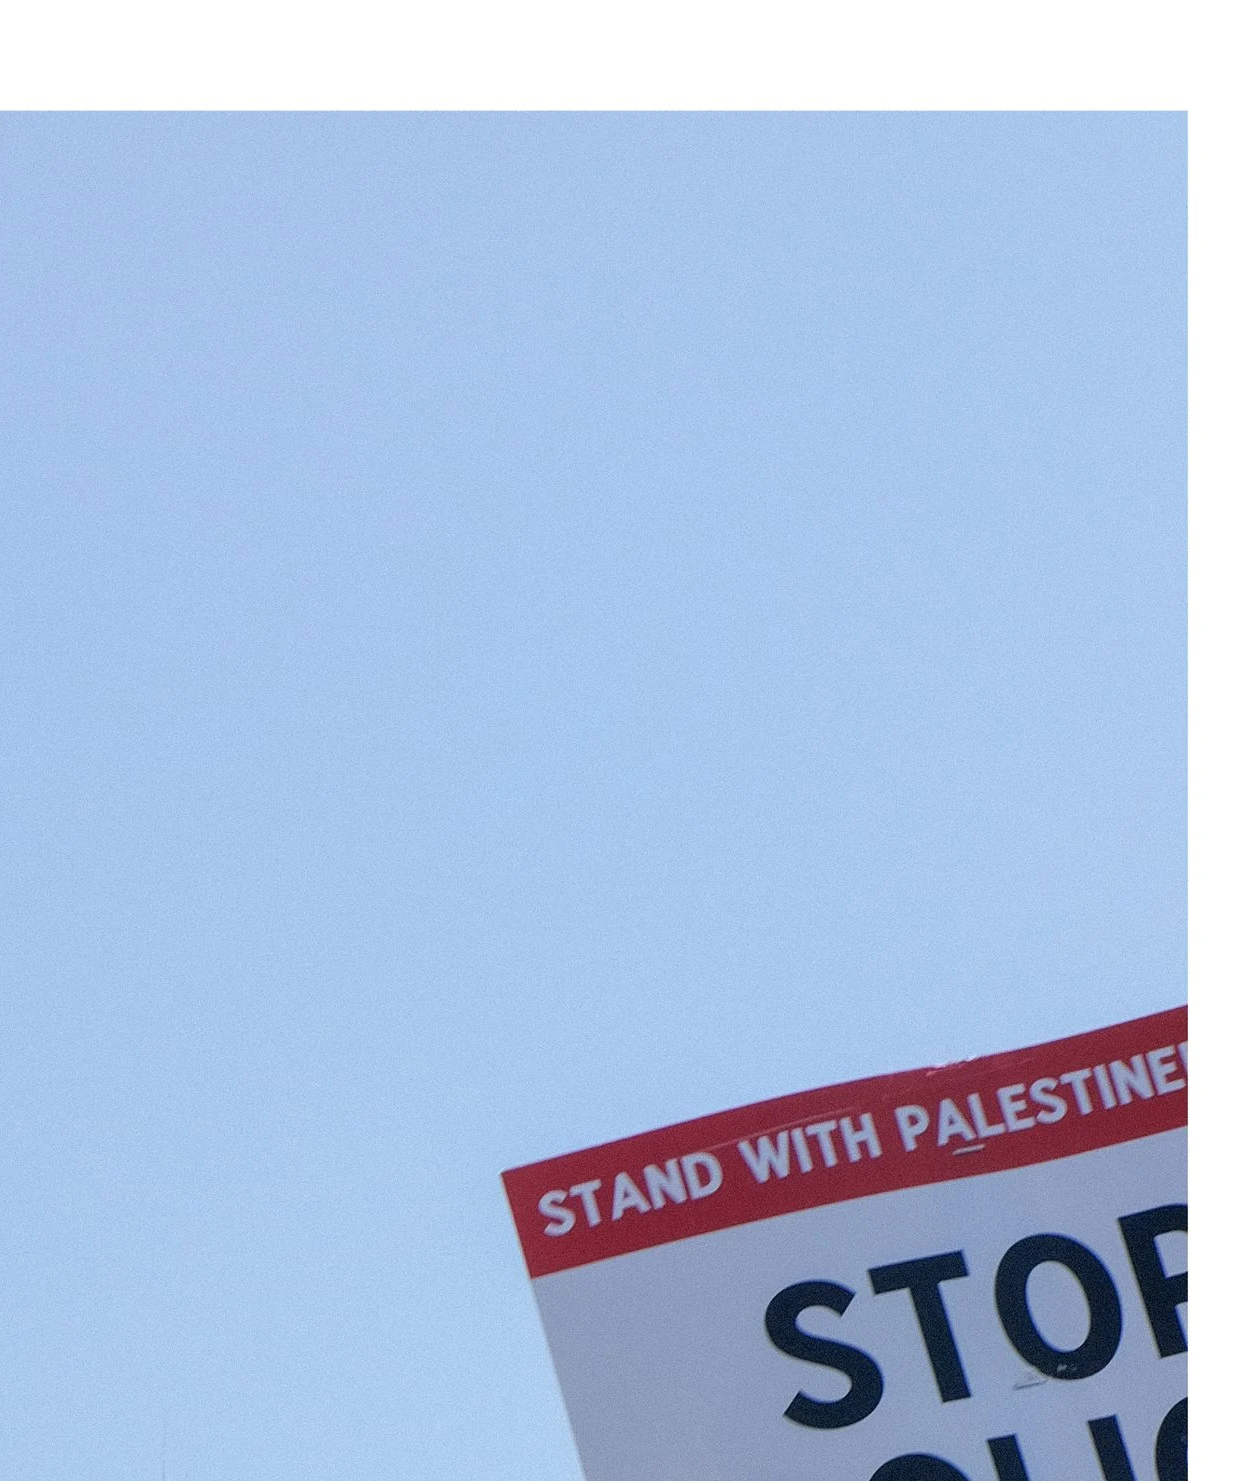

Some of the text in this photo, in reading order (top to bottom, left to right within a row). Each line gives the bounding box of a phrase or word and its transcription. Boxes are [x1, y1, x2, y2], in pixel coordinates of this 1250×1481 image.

[537, 1151, 723, 1237] STAND
[738, 1115, 883, 1184] WITH
[764, 1204, 1187, 1430] STOP
